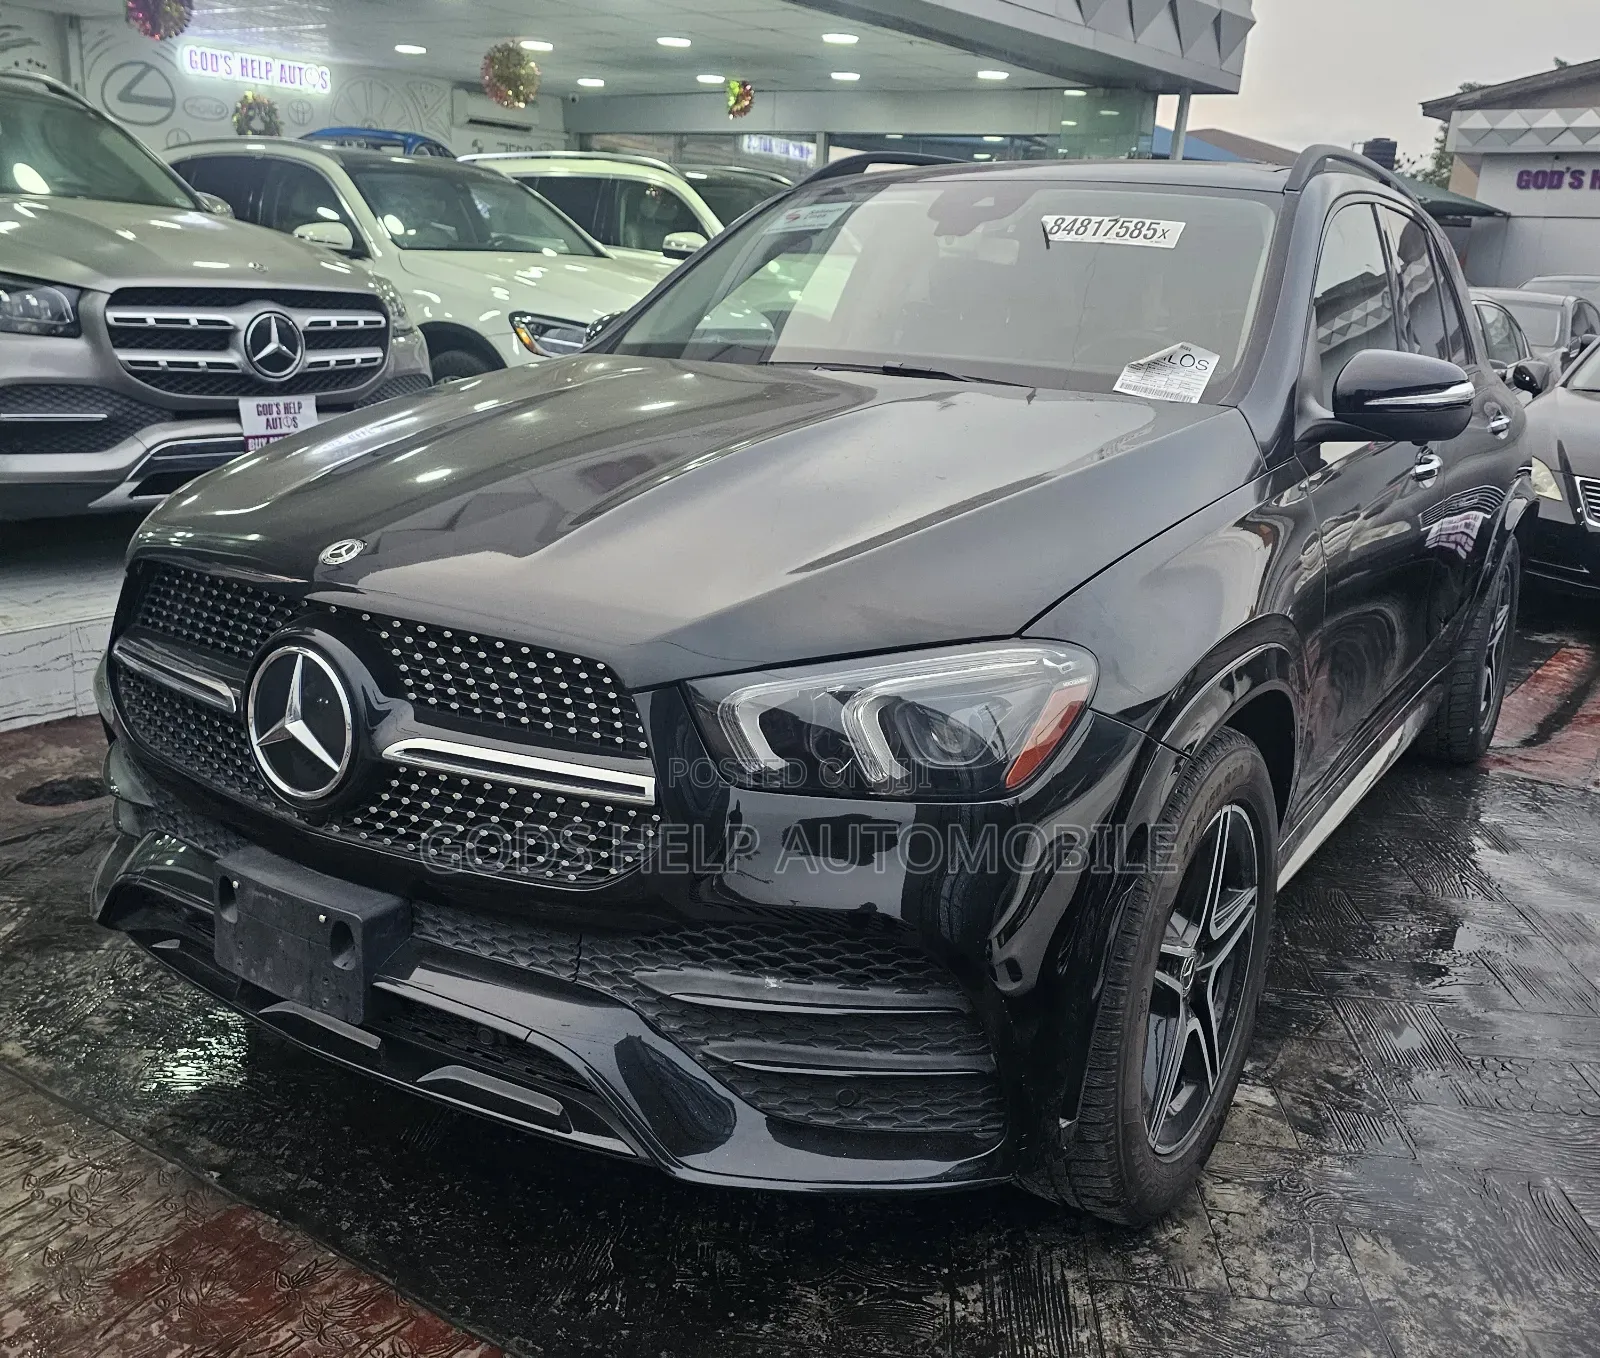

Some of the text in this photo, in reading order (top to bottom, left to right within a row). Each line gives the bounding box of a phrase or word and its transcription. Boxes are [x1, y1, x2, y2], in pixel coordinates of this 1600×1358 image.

[189, 50, 233, 75] GOD'S
[240, 56, 272, 80] HELP
[1516, 166, 1586, 190] GOD'S
[256, 401, 303, 416] GOD'S HELP
